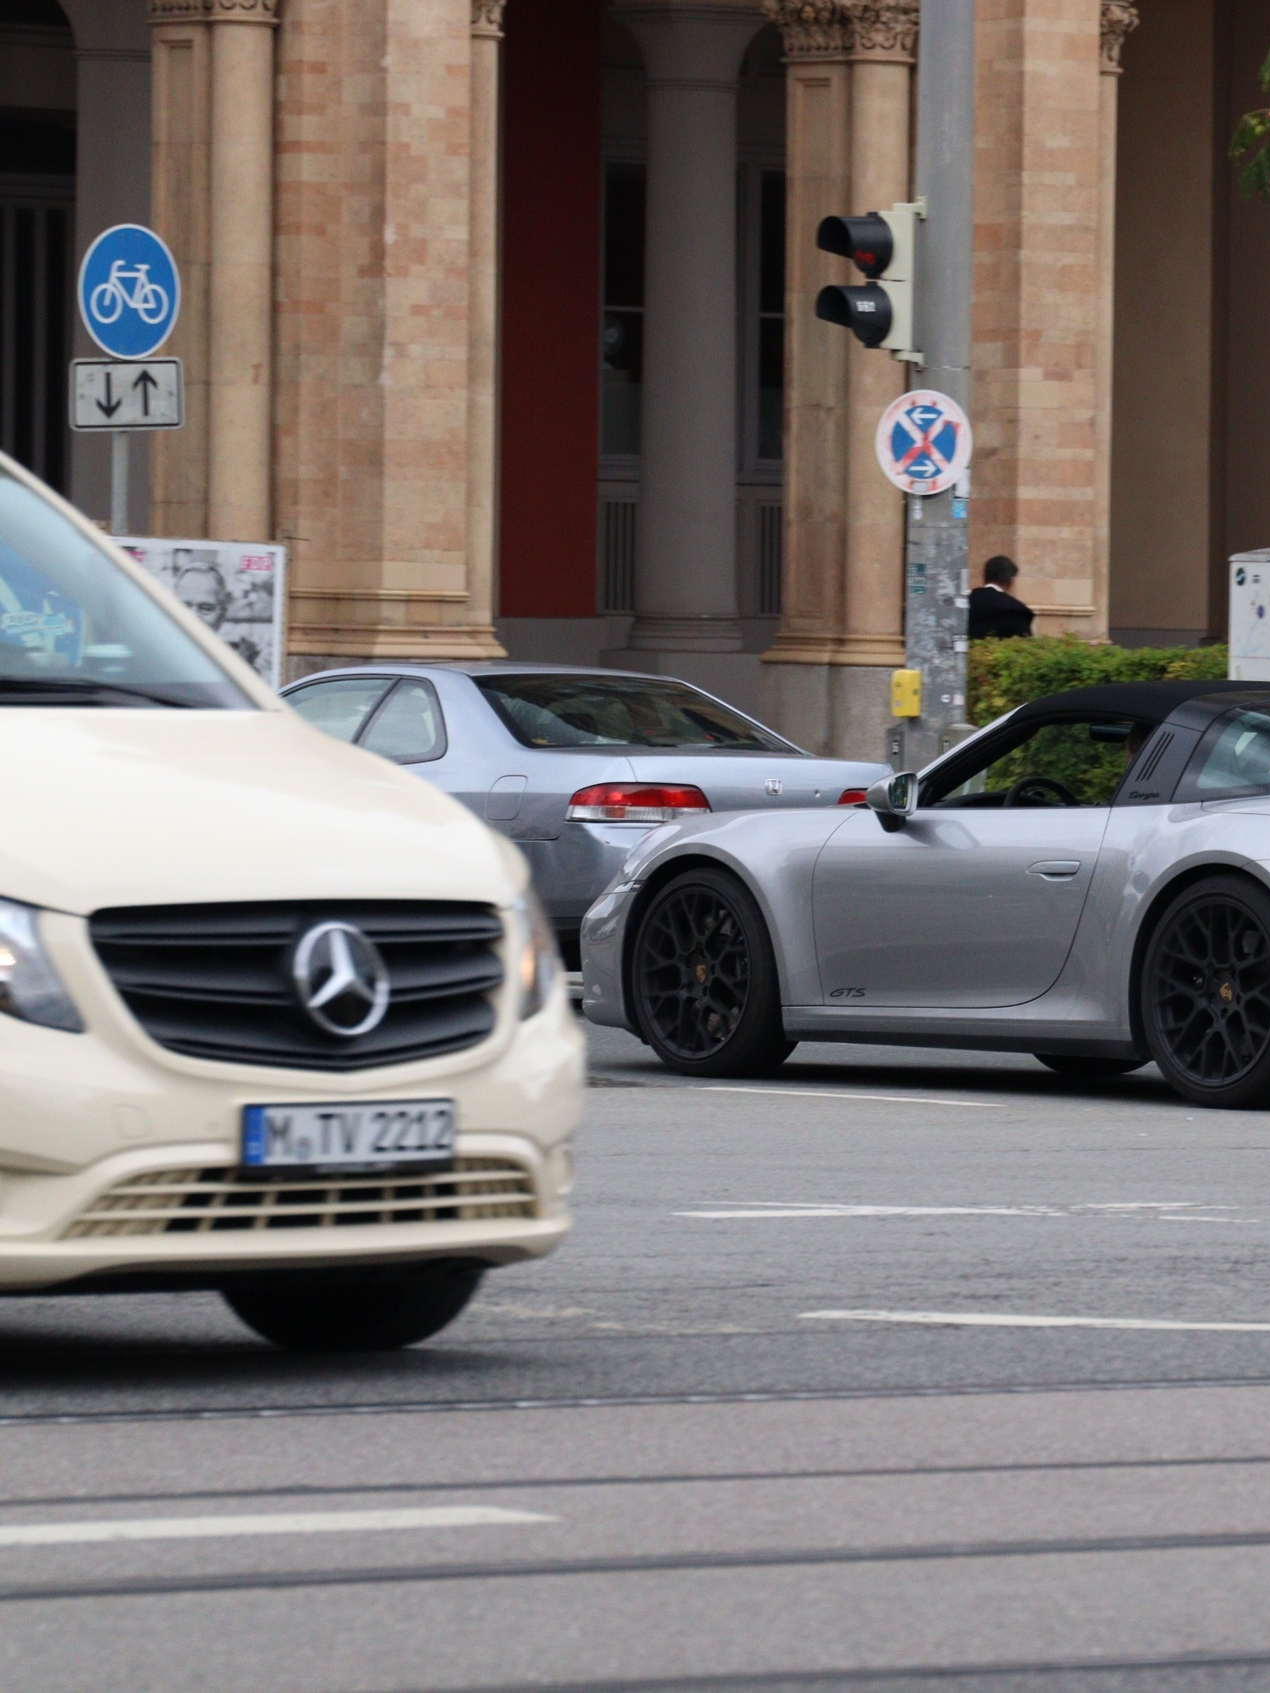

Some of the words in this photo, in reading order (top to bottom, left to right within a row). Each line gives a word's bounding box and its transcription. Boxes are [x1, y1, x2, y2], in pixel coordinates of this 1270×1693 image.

[829, 987, 866, 998] GTS
[264, 1114, 294, 1158] M
[316, 1112, 363, 1154] TV
[372, 1109, 452, 1153] 2212
